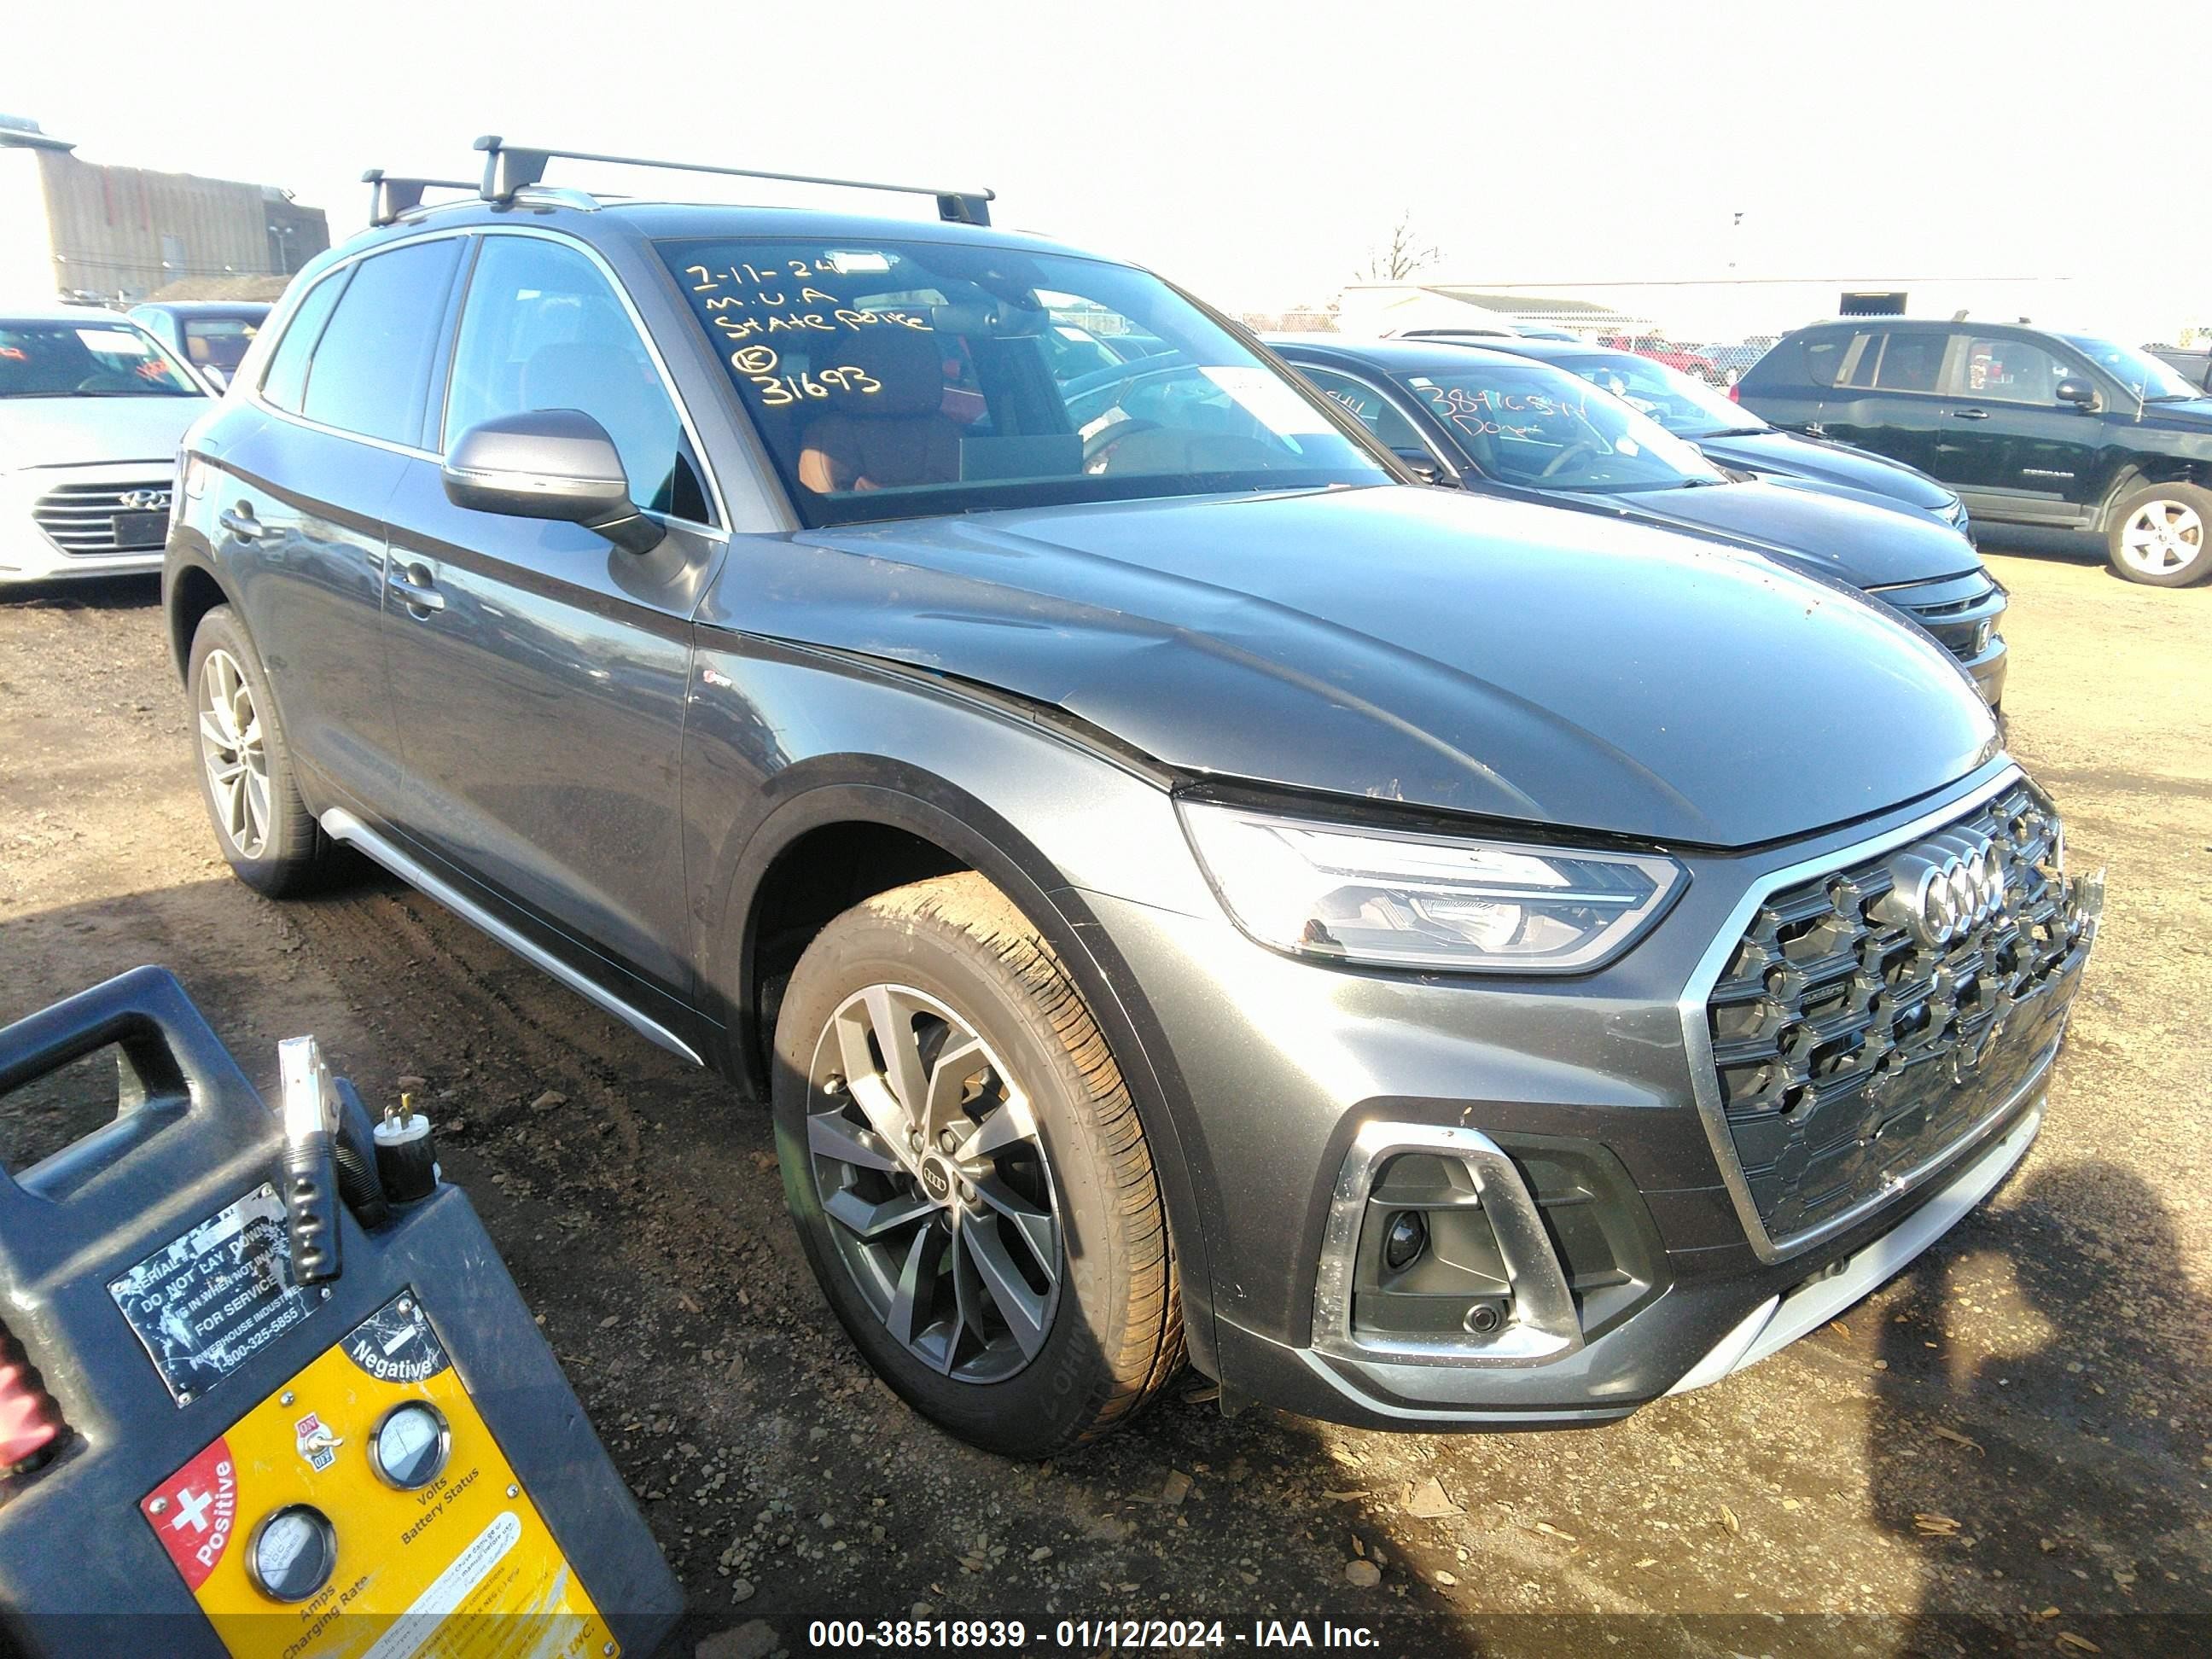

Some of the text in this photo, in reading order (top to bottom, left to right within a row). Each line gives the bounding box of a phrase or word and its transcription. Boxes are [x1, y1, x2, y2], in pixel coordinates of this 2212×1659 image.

[751, 366, 882, 405] 31693
[141, 1223, 265, 1313] DO NOT LAY DOWN
[188, 1297, 202, 1312] IN
[201, 1277, 234, 1301] WHEN
[233, 1261, 254, 1281] NOT
[195, 1274, 278, 1336] FOR SERVICE
[216, 1307, 298, 1372] 1-800-325-5855
[352, 1339, 433, 1378] Negative
[299, 1417, 317, 1434] ON
[315, 1452, 332, 1469] OFF
[195, 1460, 233, 1568] Positive
[401, 1467, 480, 1545] Battery Status
[416, 1476, 448, 1506] Volts
[282, 1605, 341, 1659] Charging
[339, 1575, 370, 1606] Rate
[300, 1585, 336, 1622] Amps
